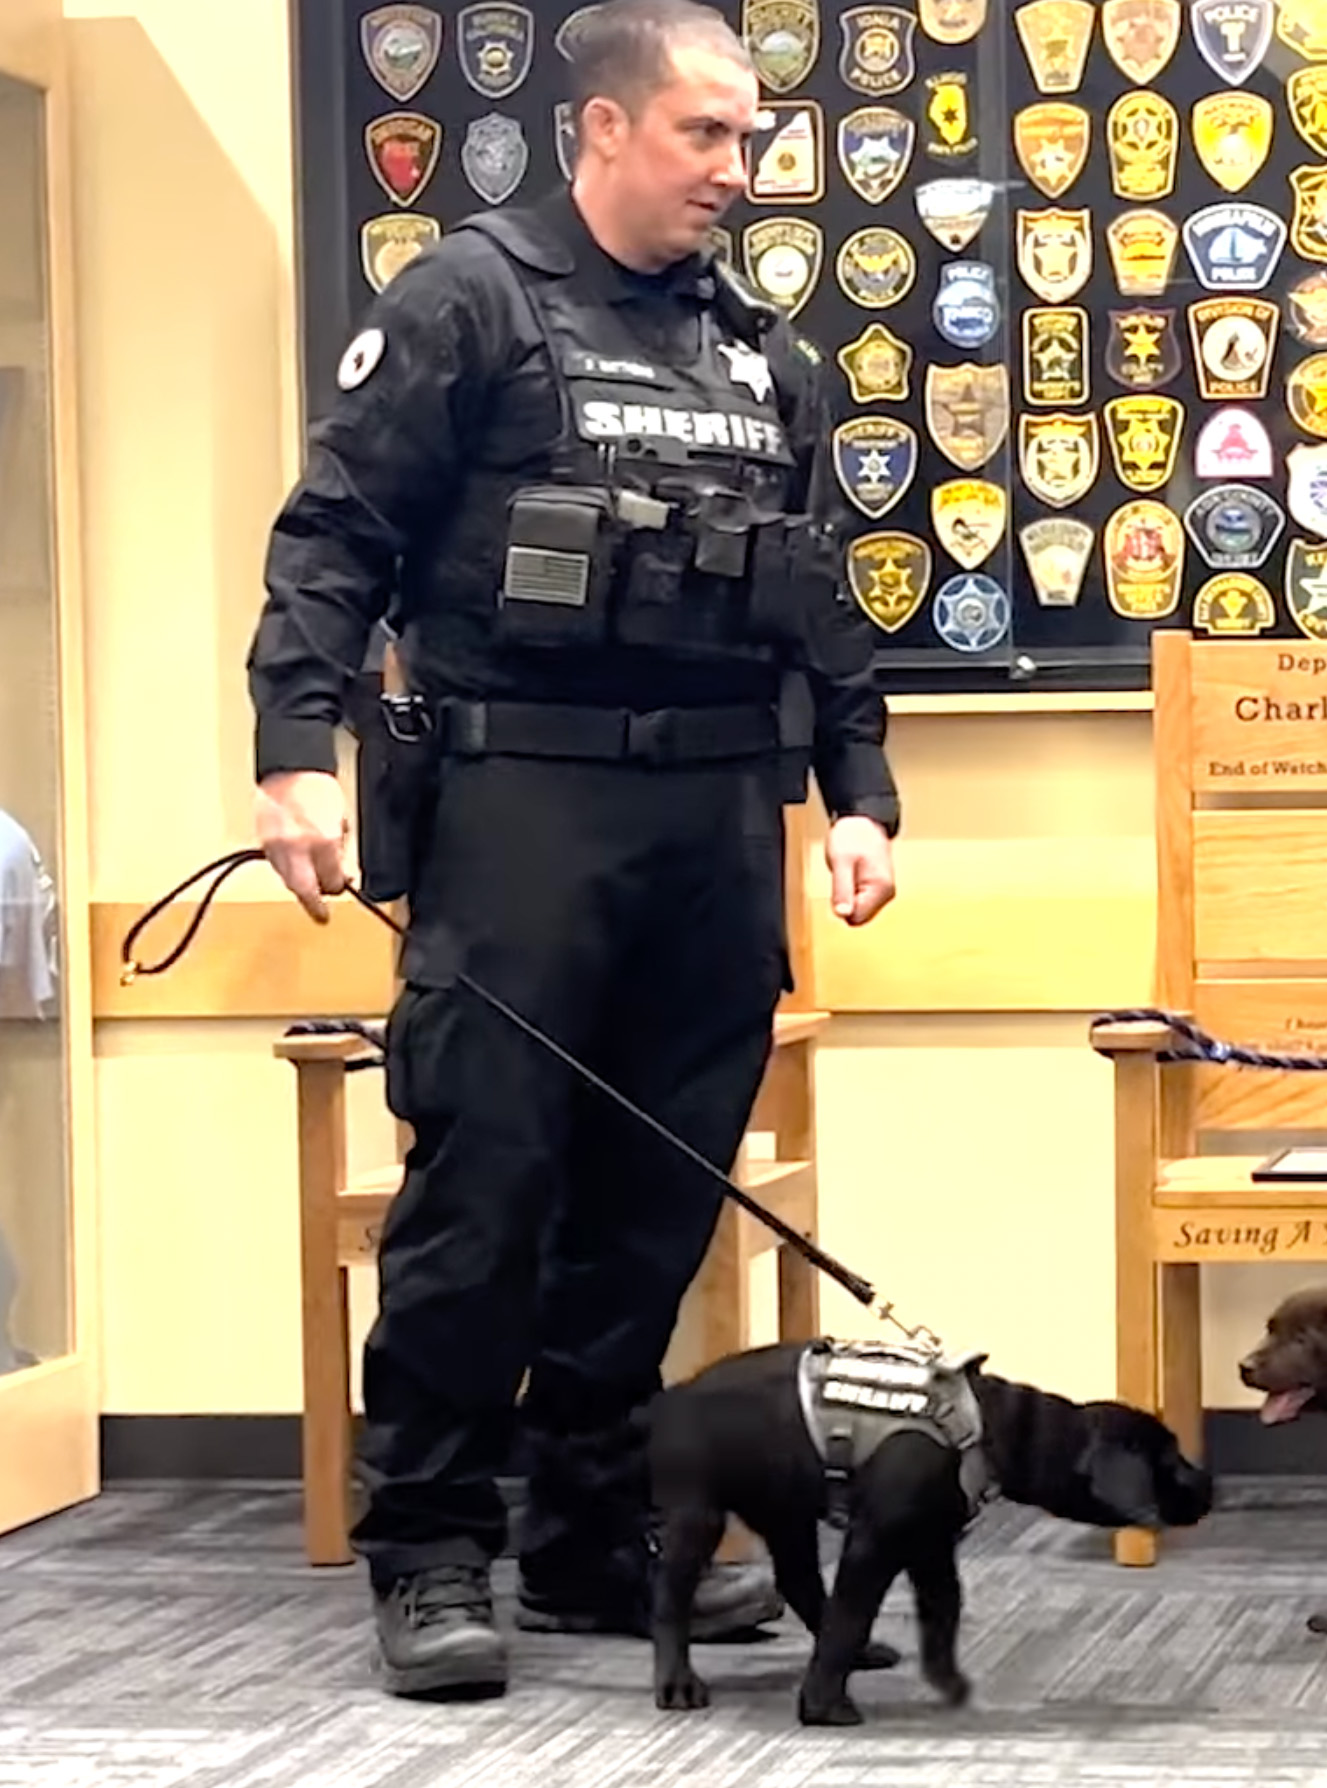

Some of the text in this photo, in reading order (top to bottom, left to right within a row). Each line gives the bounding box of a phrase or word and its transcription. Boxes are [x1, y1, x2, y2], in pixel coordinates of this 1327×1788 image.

[1204, 5, 1260, 24] POLICE
[583, 401, 782, 454] SHERIFF
[1209, 760, 1245, 776] End
[1250, 760, 1268, 775] of
[1173, 1221, 1279, 1255] Saving
[1285, 1219, 1312, 1250] A
